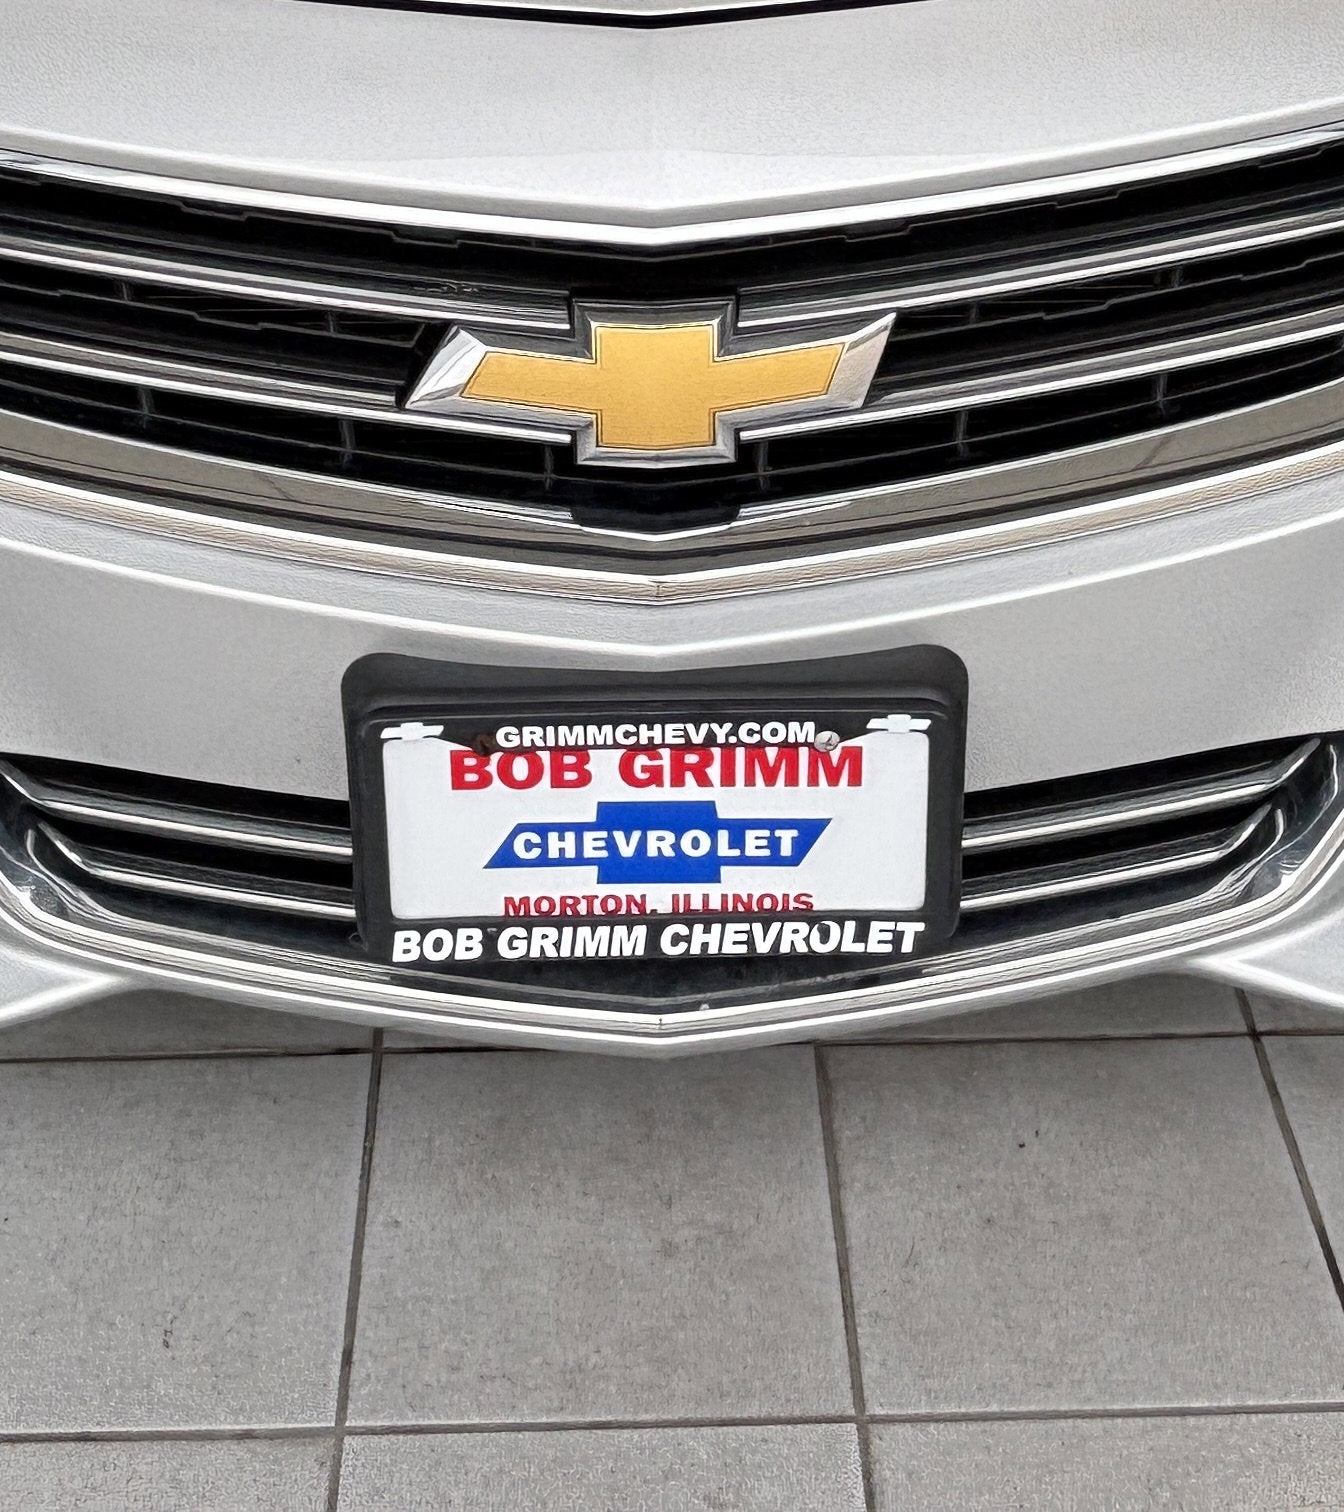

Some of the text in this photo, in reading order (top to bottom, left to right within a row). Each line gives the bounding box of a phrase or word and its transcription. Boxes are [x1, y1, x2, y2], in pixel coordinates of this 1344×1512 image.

[495, 721, 816, 749] GRIMMCHEVY.COM
[450, 745, 863, 791] BOB GRIMM
[512, 828, 800, 859] CHEVROLET
[672, 892, 813, 914] ILLINOIS
[392, 920, 925, 963] BOB GRIMM CHEVROLET
